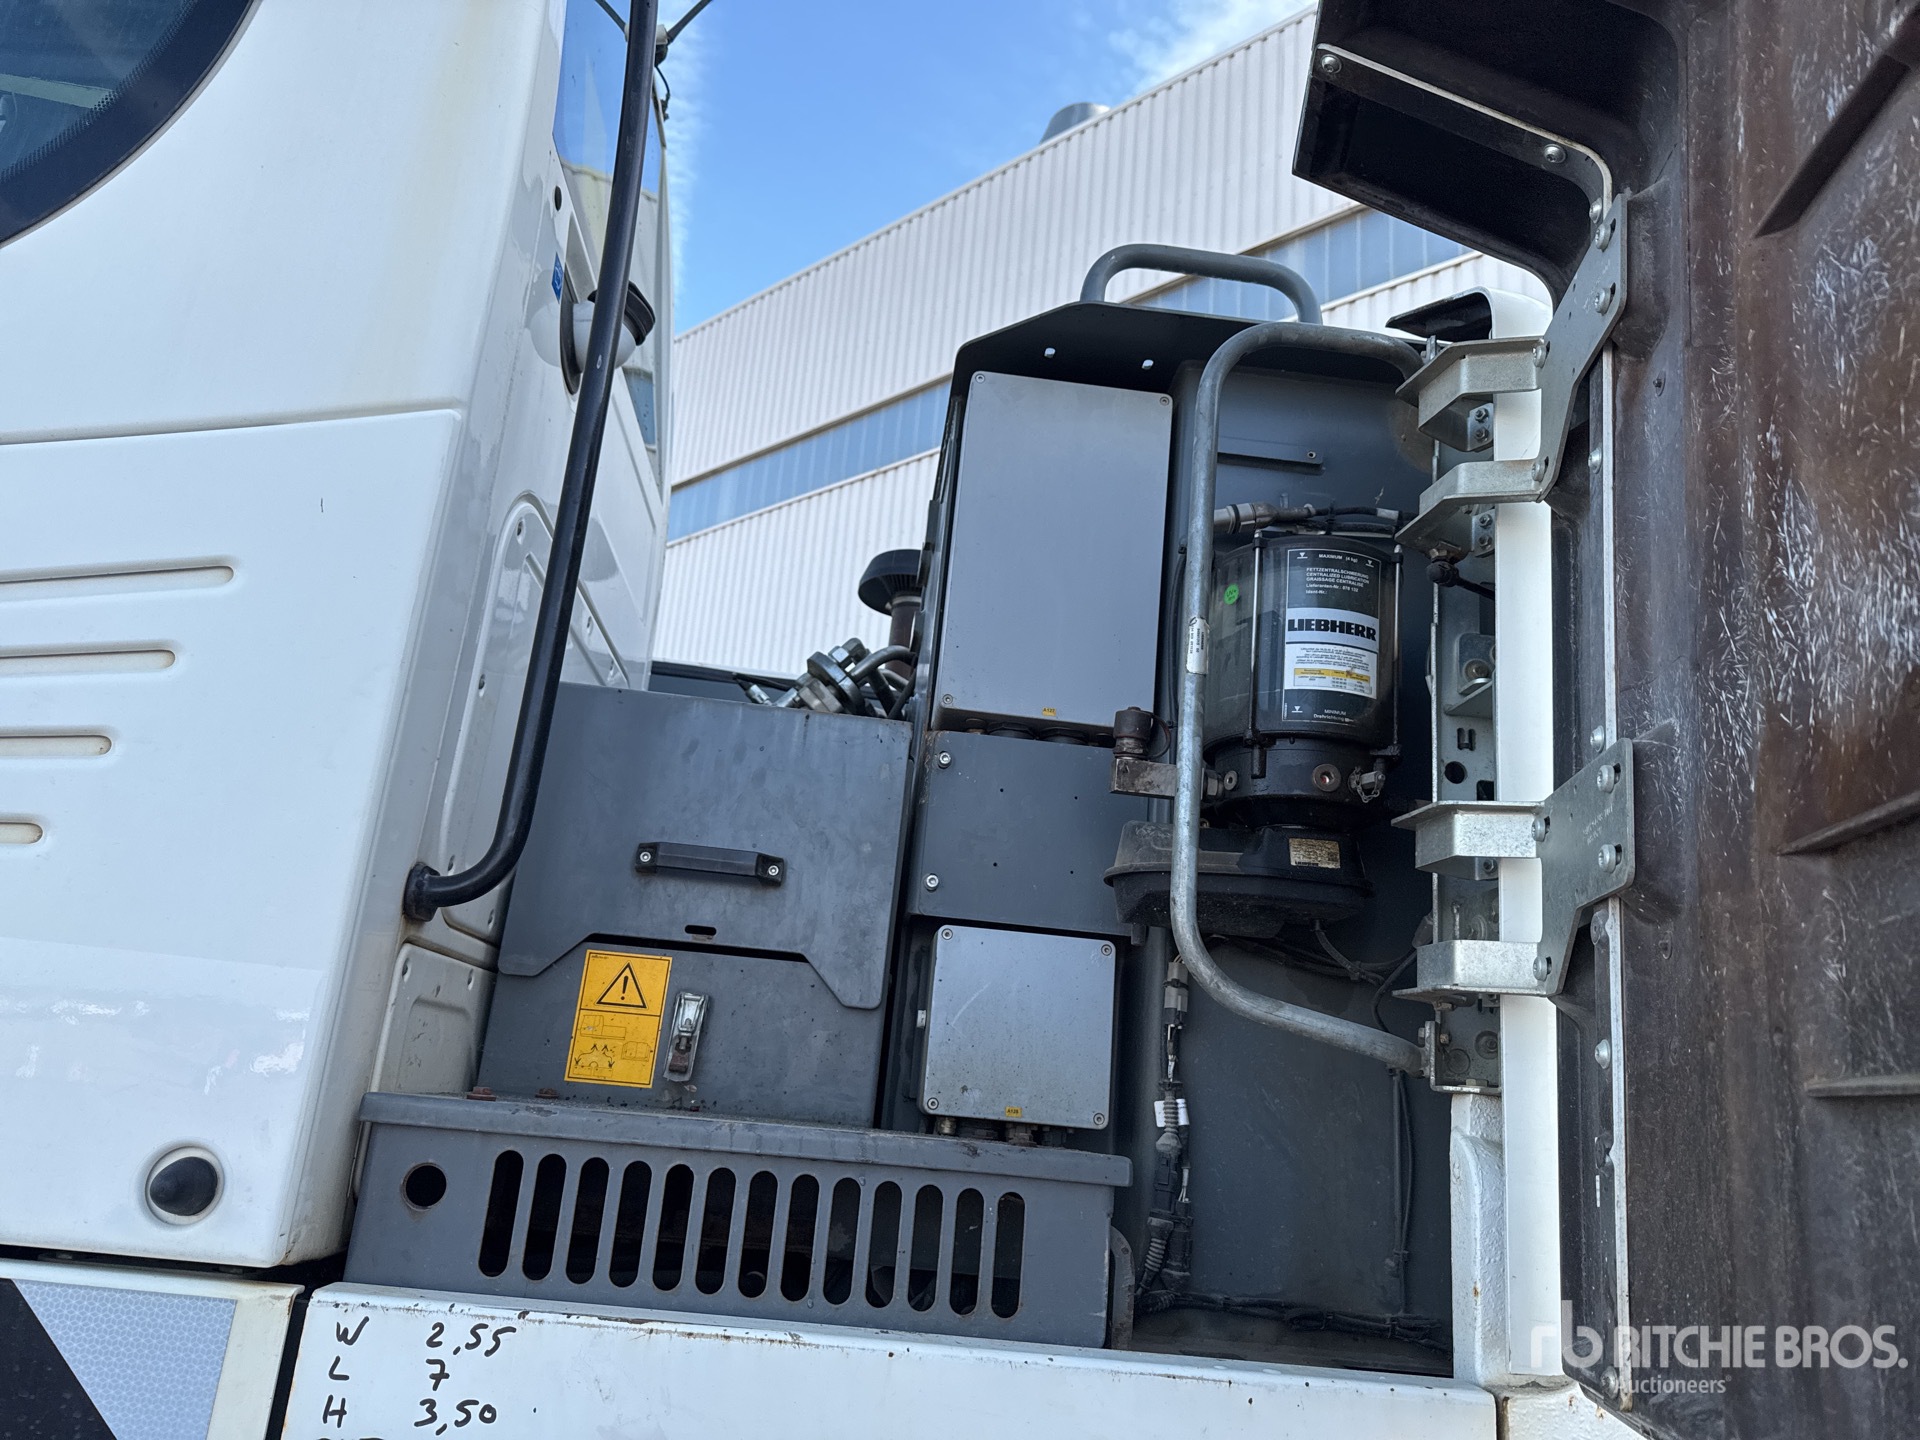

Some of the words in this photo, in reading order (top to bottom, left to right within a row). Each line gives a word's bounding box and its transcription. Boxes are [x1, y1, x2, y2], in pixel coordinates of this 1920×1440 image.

[1306, 568, 1370, 579] FETTZENTRALSCHMIERUNG
[1341, 574, 1370, 584] LUBRICATION
[1288, 618, 1376, 642] LIEBHERR
[336, 1316, 370, 1346] W
[426, 1322, 517, 1357] 2,55
[328, 1355, 350, 1381] L
[425, 1358, 450, 1391] 7
[322, 1394, 347, 1428] H
[413, 1398, 497, 1436] 3,50
